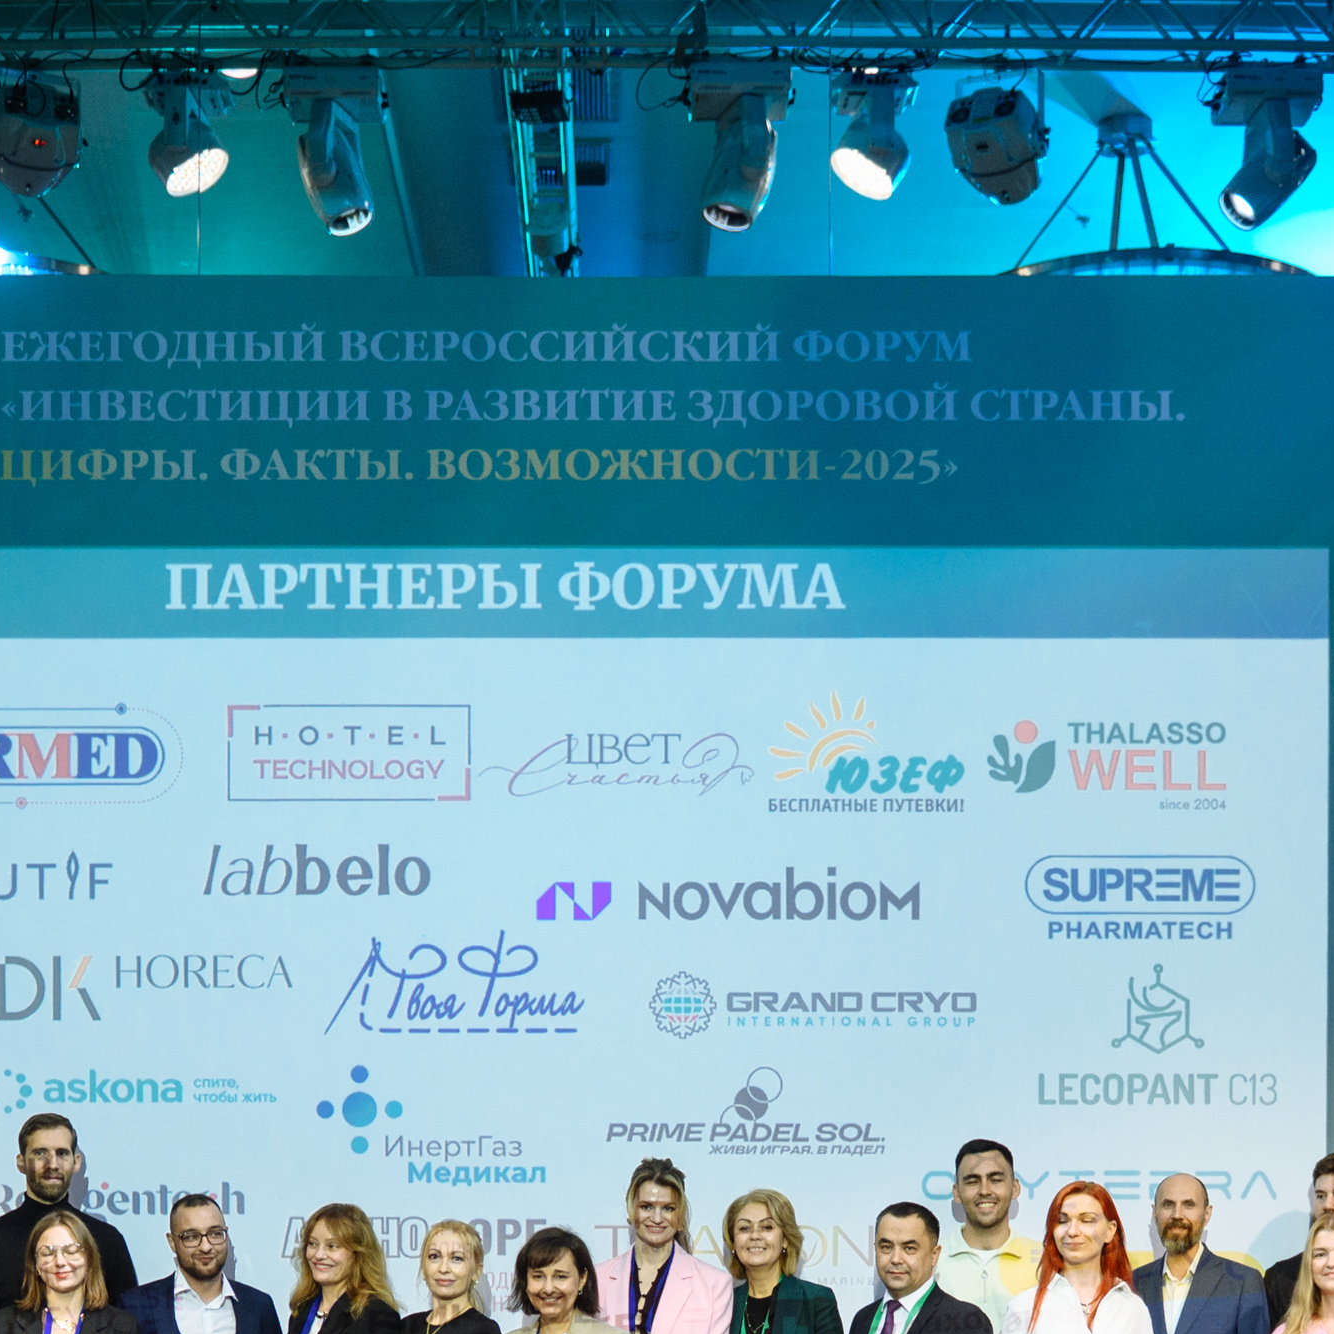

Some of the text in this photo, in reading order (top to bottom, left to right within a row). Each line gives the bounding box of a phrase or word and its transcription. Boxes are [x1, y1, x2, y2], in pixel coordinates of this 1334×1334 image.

[1, 323, 973, 368] ЕЖЕГОДНЫЙ ВСЕРОССИЙСКИЙ ФОРУМ
[0, 382, 1186, 429] «ИНВЕСТИЦИИ В РАЗВИТИЕ ЗДОРОВОЙ СТРАНЫ.
[0, 448, 959, 487] ЦИФРЫ. ФАКТЫ. ВОЗМОЖНОСТИ-2025»
[164, 561, 847, 611] ПАРТНЕРЫ ФОРУМА
[1068, 722, 1227, 745] THALASSO
[253, 759, 445, 780] TECHNOLOGY
[825, 754, 966, 795] ЮЗЕФ
[1068, 750, 1227, 791] WELL
[768, 798, 965, 813] БЕСПЛАТНЫЕ ПУТЕВКИ!
[1159, 799, 1227, 810] since 2004
[203, 844, 431, 896] labbelo
[1042, 868, 1241, 903] SUPREME
[1048, 921, 1234, 940] PHARMATECH
[114, 954, 293, 989] HORECA
[727, 992, 978, 1013] GRAND CRYO
[727, 1017, 977, 1027] INTERNATIONAL GROUP
[43, 1069, 183, 1104] askona
[193, 1077, 239, 1091] спите,
[1038, 1073, 1278, 1106] LECOPANT C13
[193, 1091, 277, 1104] чтобы жить
[606, 1123, 887, 1143] PRIME PADEL SOL.
[384, 1135, 523, 1163] ИнертГаз
[708, 1145, 887, 1157] ЖИВИ ИГРАЯ. В ПАДЕЛ
[407, 1162, 547, 1187] Медикал
